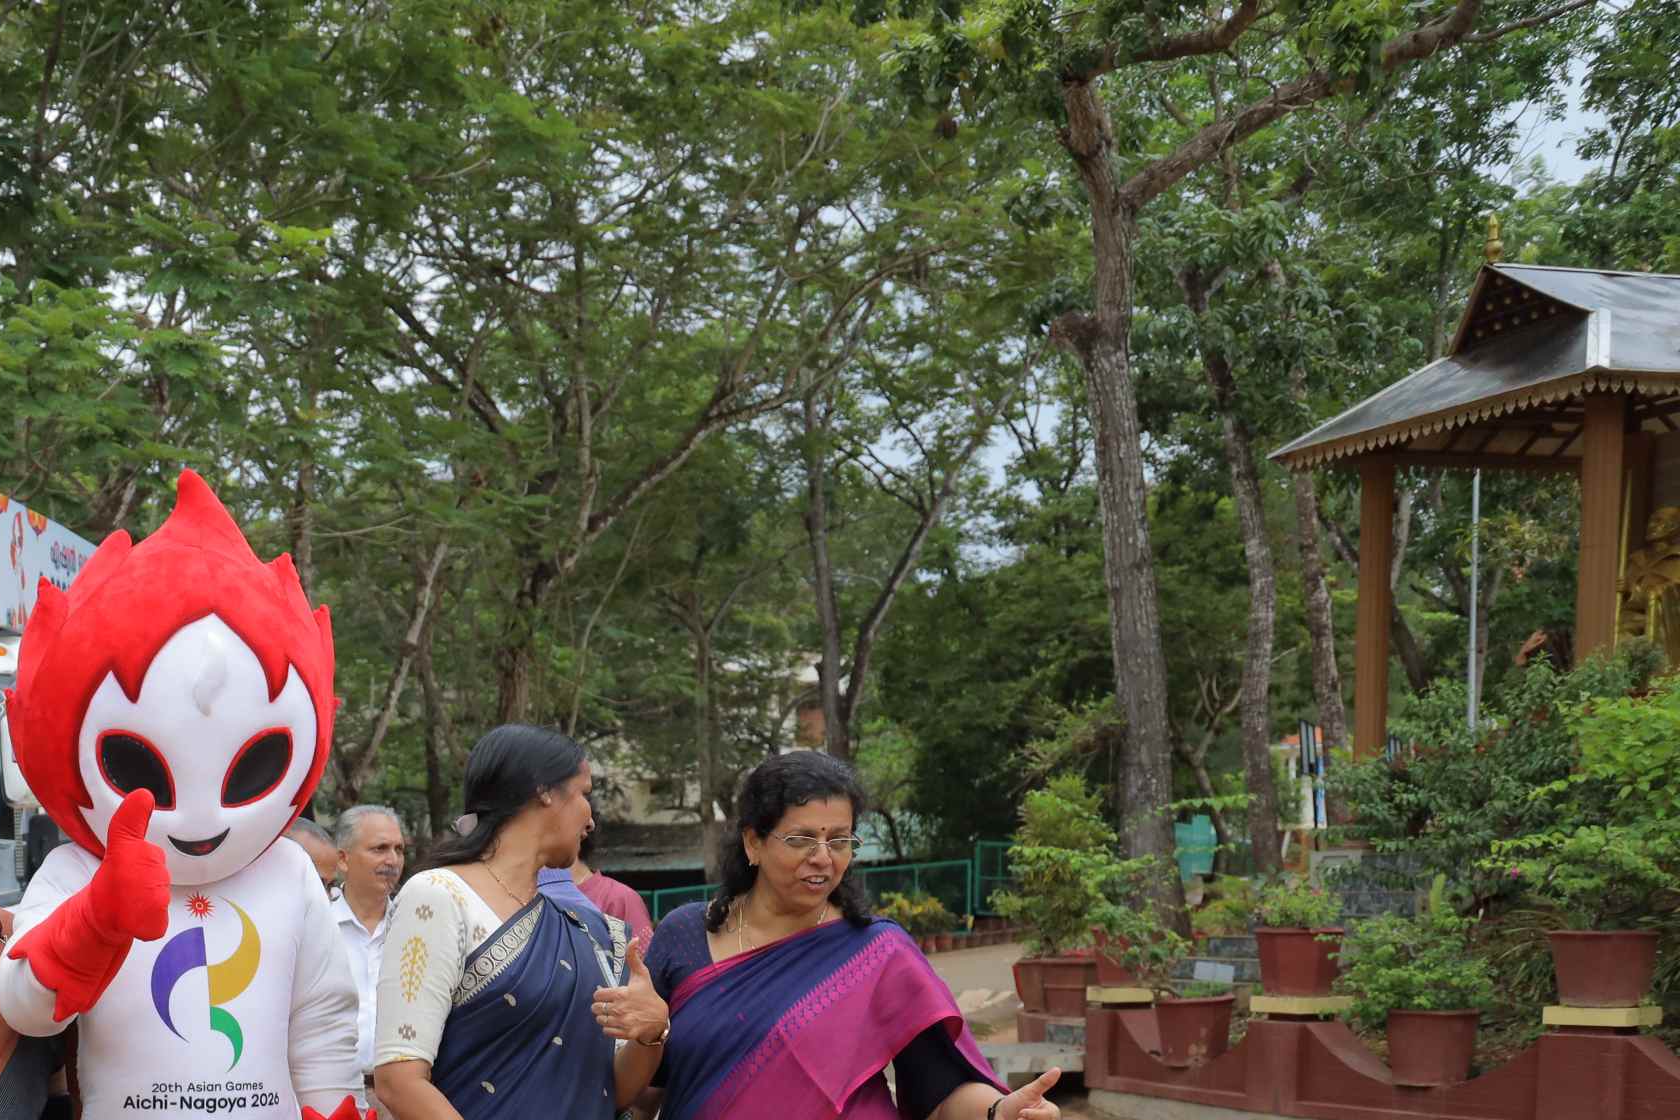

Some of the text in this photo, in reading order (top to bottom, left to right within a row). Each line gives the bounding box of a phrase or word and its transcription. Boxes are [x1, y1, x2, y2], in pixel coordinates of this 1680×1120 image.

[151, 1080, 264, 1093] 20th Asian Games
[123, 1091, 280, 1113] Aichi-Nagoya 2026
